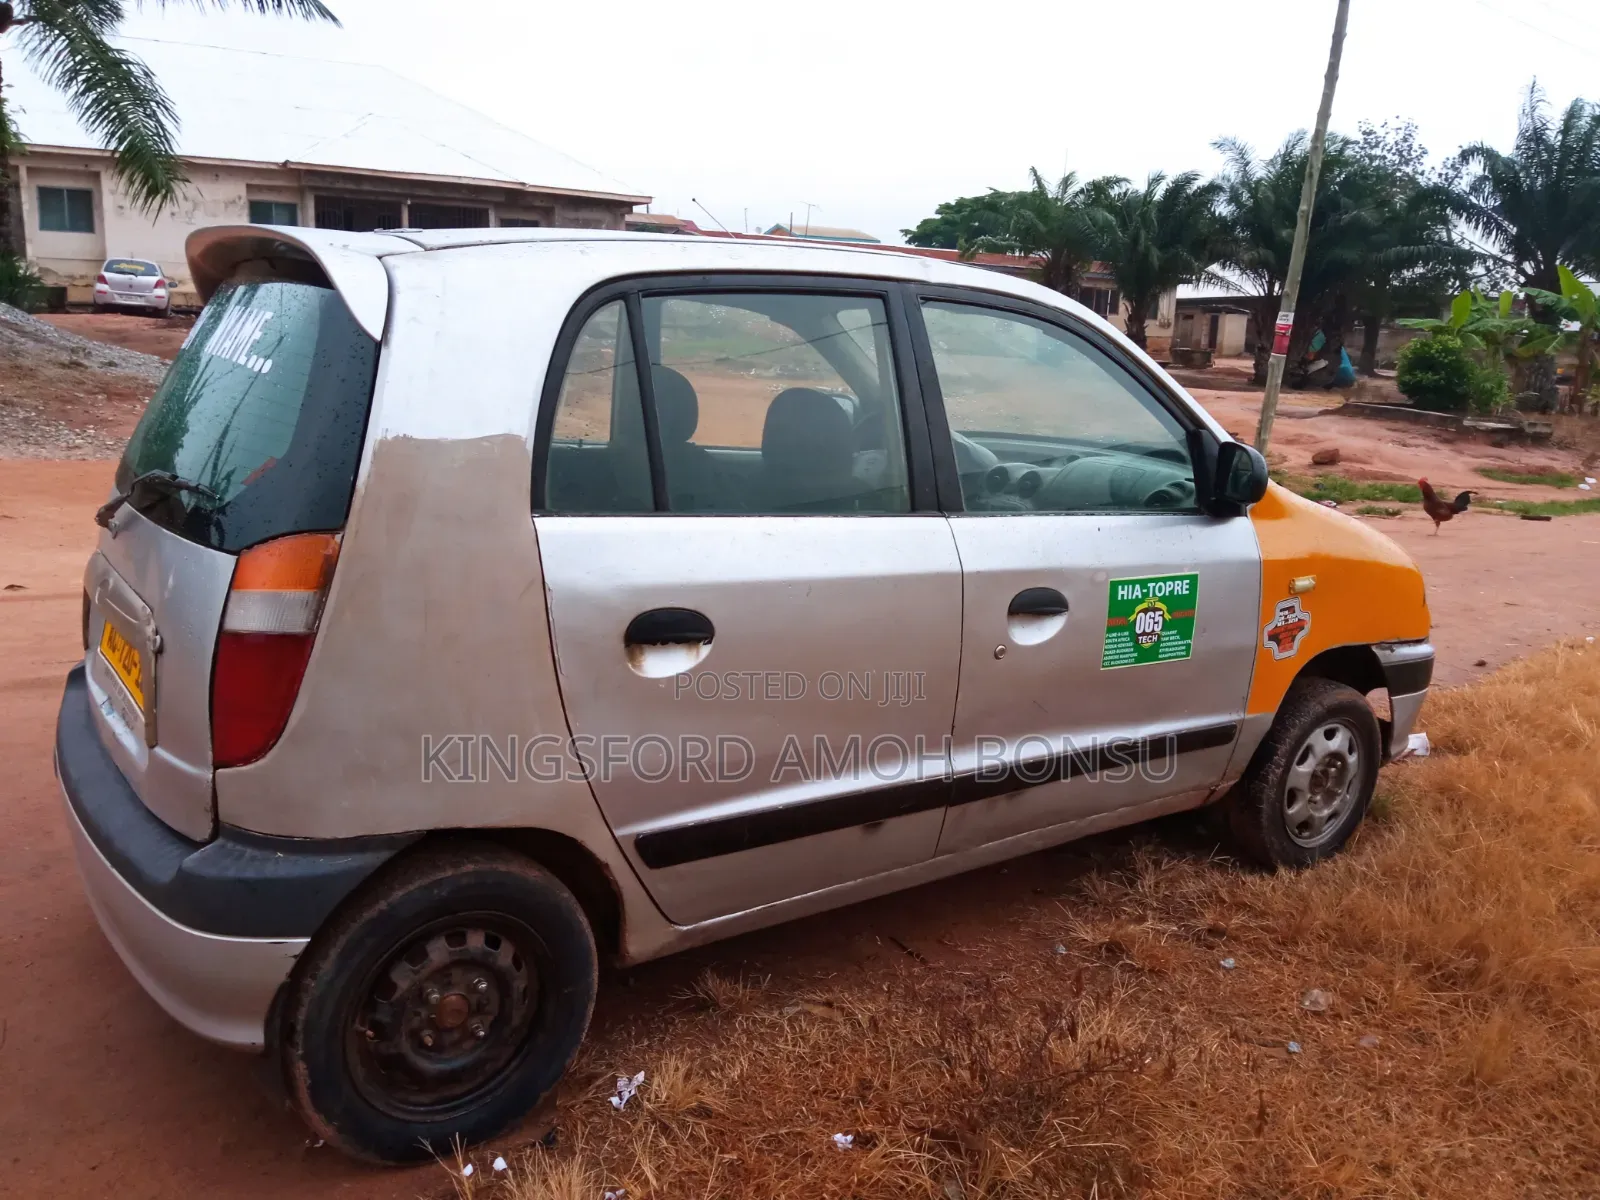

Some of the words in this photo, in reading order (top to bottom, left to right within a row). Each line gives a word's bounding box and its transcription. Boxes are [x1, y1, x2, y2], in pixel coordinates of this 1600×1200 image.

[1117, 580, 1190, 600] HIA-TOPRE
[1135, 611, 1163, 634] 065
[1138, 634, 1158, 644] TECH
